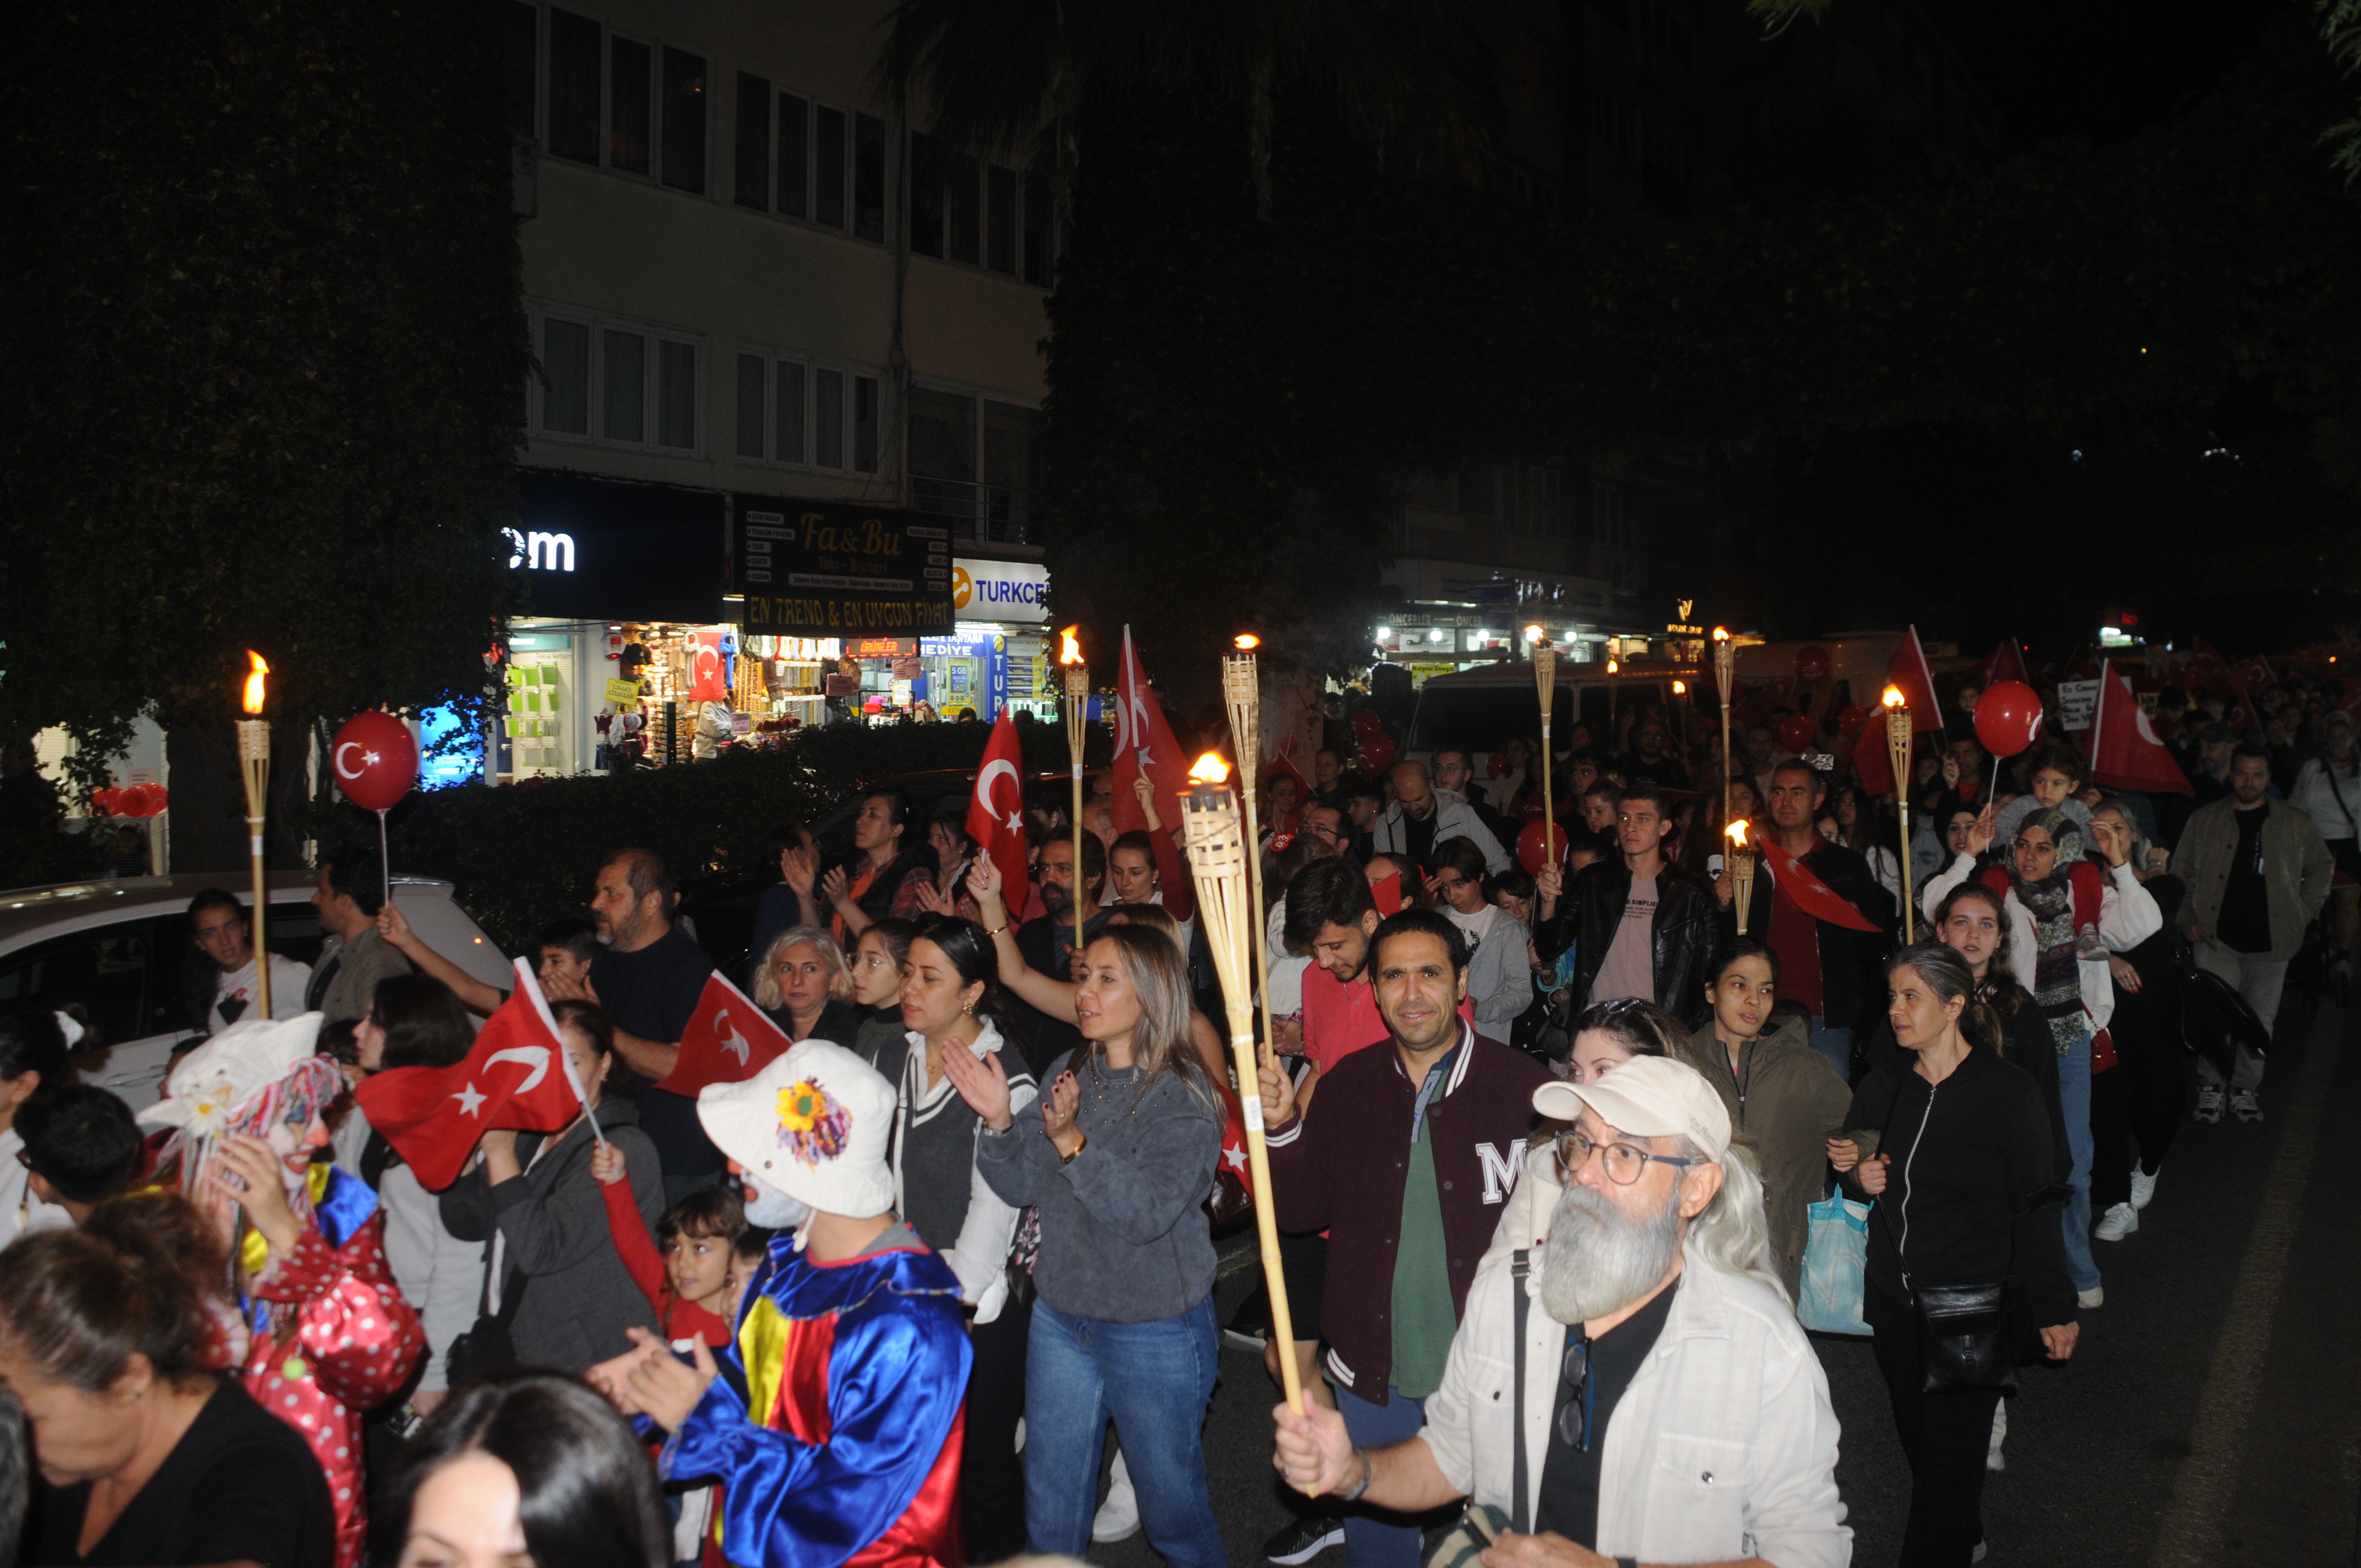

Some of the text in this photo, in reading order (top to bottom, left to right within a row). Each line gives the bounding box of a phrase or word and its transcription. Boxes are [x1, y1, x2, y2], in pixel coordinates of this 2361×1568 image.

[752, 557, 768, 565] ÇANTA
[750, 597, 770, 623] EN
[775, 598, 824, 625] TREND
[844, 601, 863, 627] EN
[866, 601, 912, 627] UYGUN
[915, 597, 949, 626] FİYAT
[1475, 1139, 1527, 1205] M
